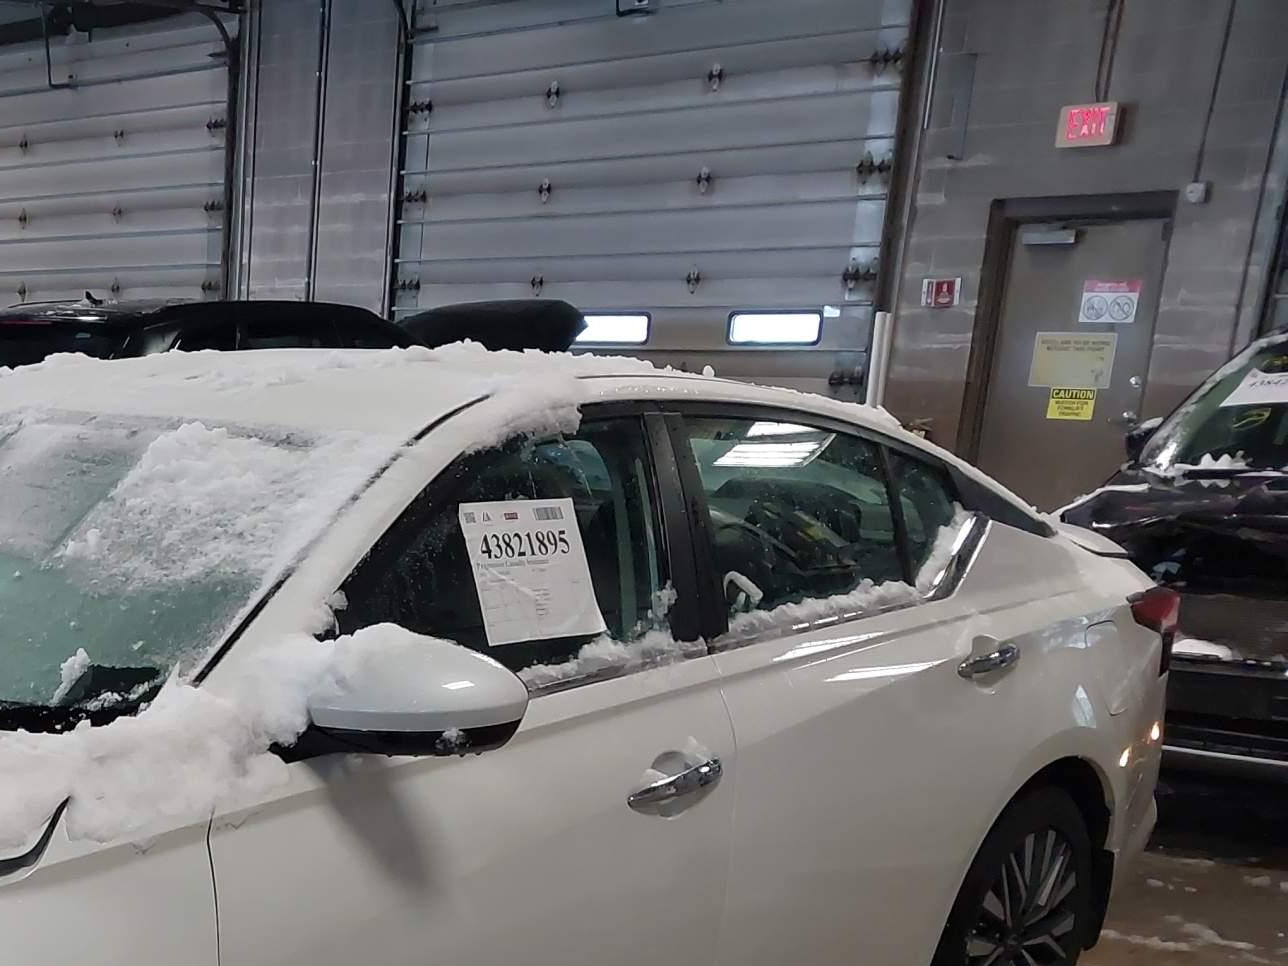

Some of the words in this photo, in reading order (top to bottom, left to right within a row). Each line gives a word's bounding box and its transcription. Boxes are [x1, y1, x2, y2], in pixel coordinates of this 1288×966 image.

[1066, 107, 1110, 140] EXIT
[1053, 389, 1094, 399] CAUTION
[480, 529, 570, 559] 43821895
